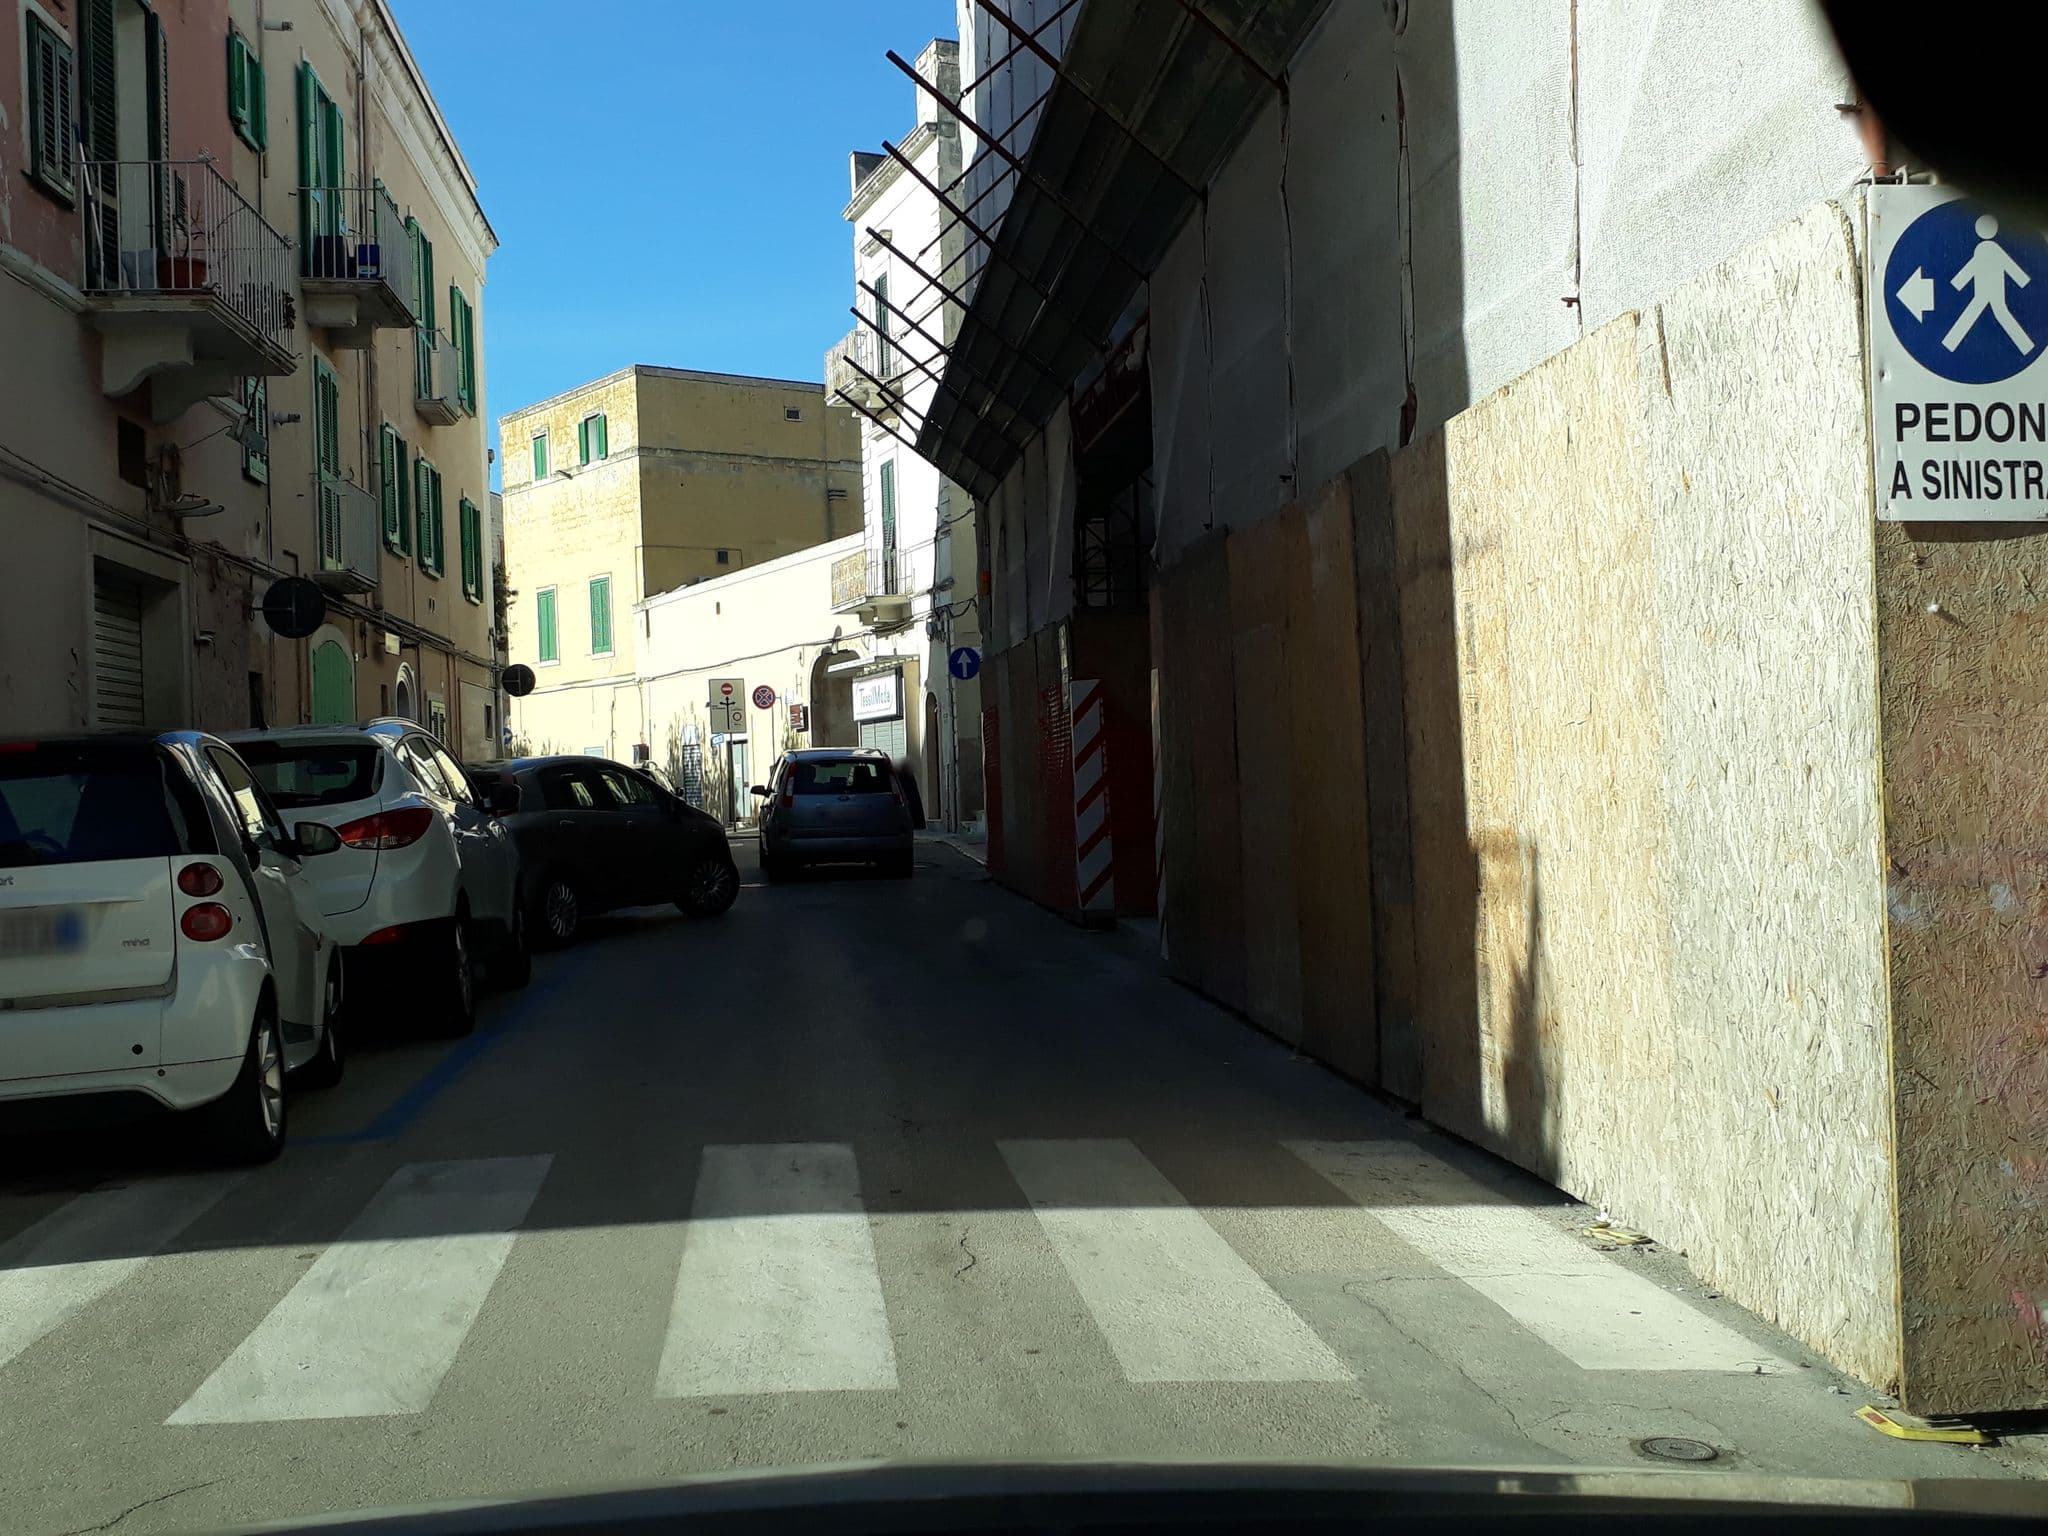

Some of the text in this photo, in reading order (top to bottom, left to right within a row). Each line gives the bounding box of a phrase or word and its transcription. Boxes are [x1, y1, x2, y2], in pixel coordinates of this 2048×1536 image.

[1895, 402, 2046, 443] PEDON
[1891, 459, 2048, 500] A SINISTR
